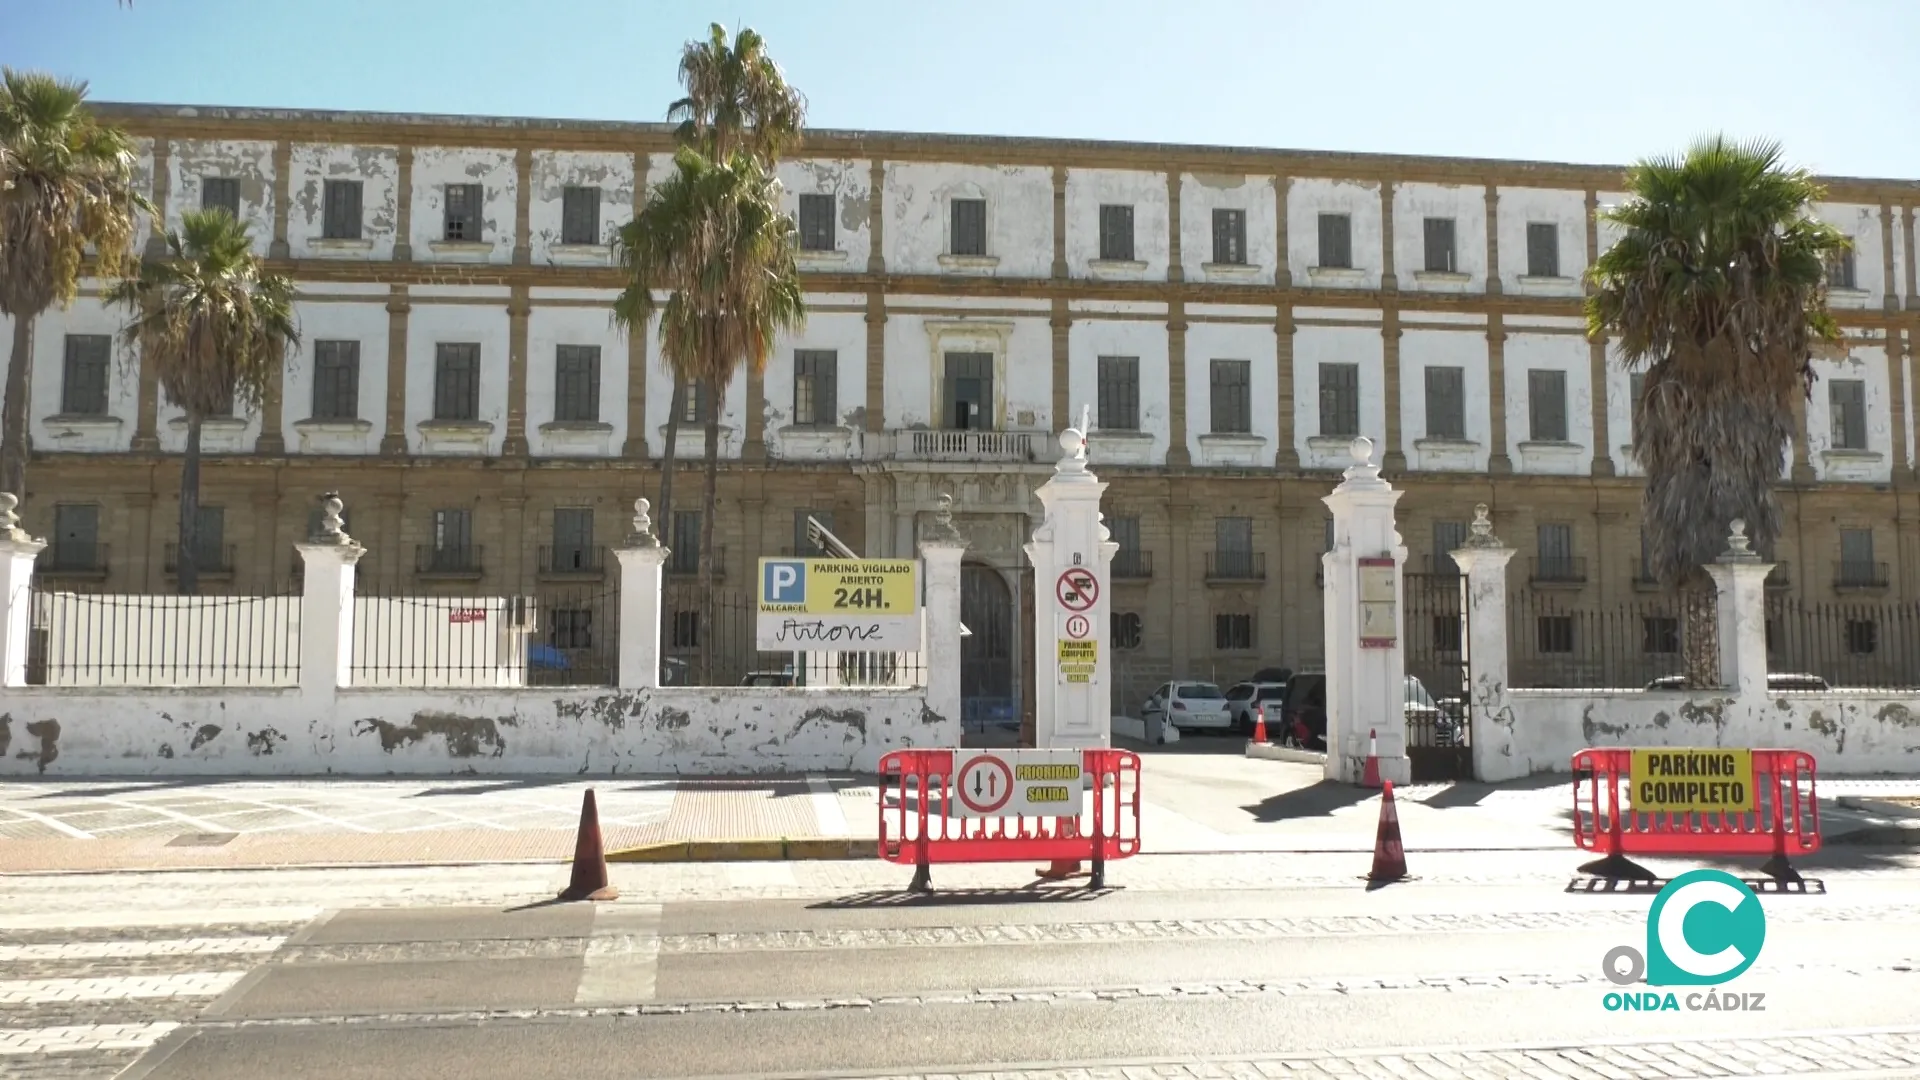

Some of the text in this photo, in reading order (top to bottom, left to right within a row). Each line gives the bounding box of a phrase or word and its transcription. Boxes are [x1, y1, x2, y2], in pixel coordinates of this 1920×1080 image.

[814, 564, 911, 574] PARKING VIGILADO
[772, 565, 797, 600] P
[840, 576, 884, 585] ABIERTO
[834, 588, 891, 609] 24H.
[1015, 764, 1080, 781] PRIORIDAD
[1647, 754, 1735, 777] PARKING
[1026, 786, 1069, 802] SALIDA
[1640, 781, 1744, 804] COMPLETO
